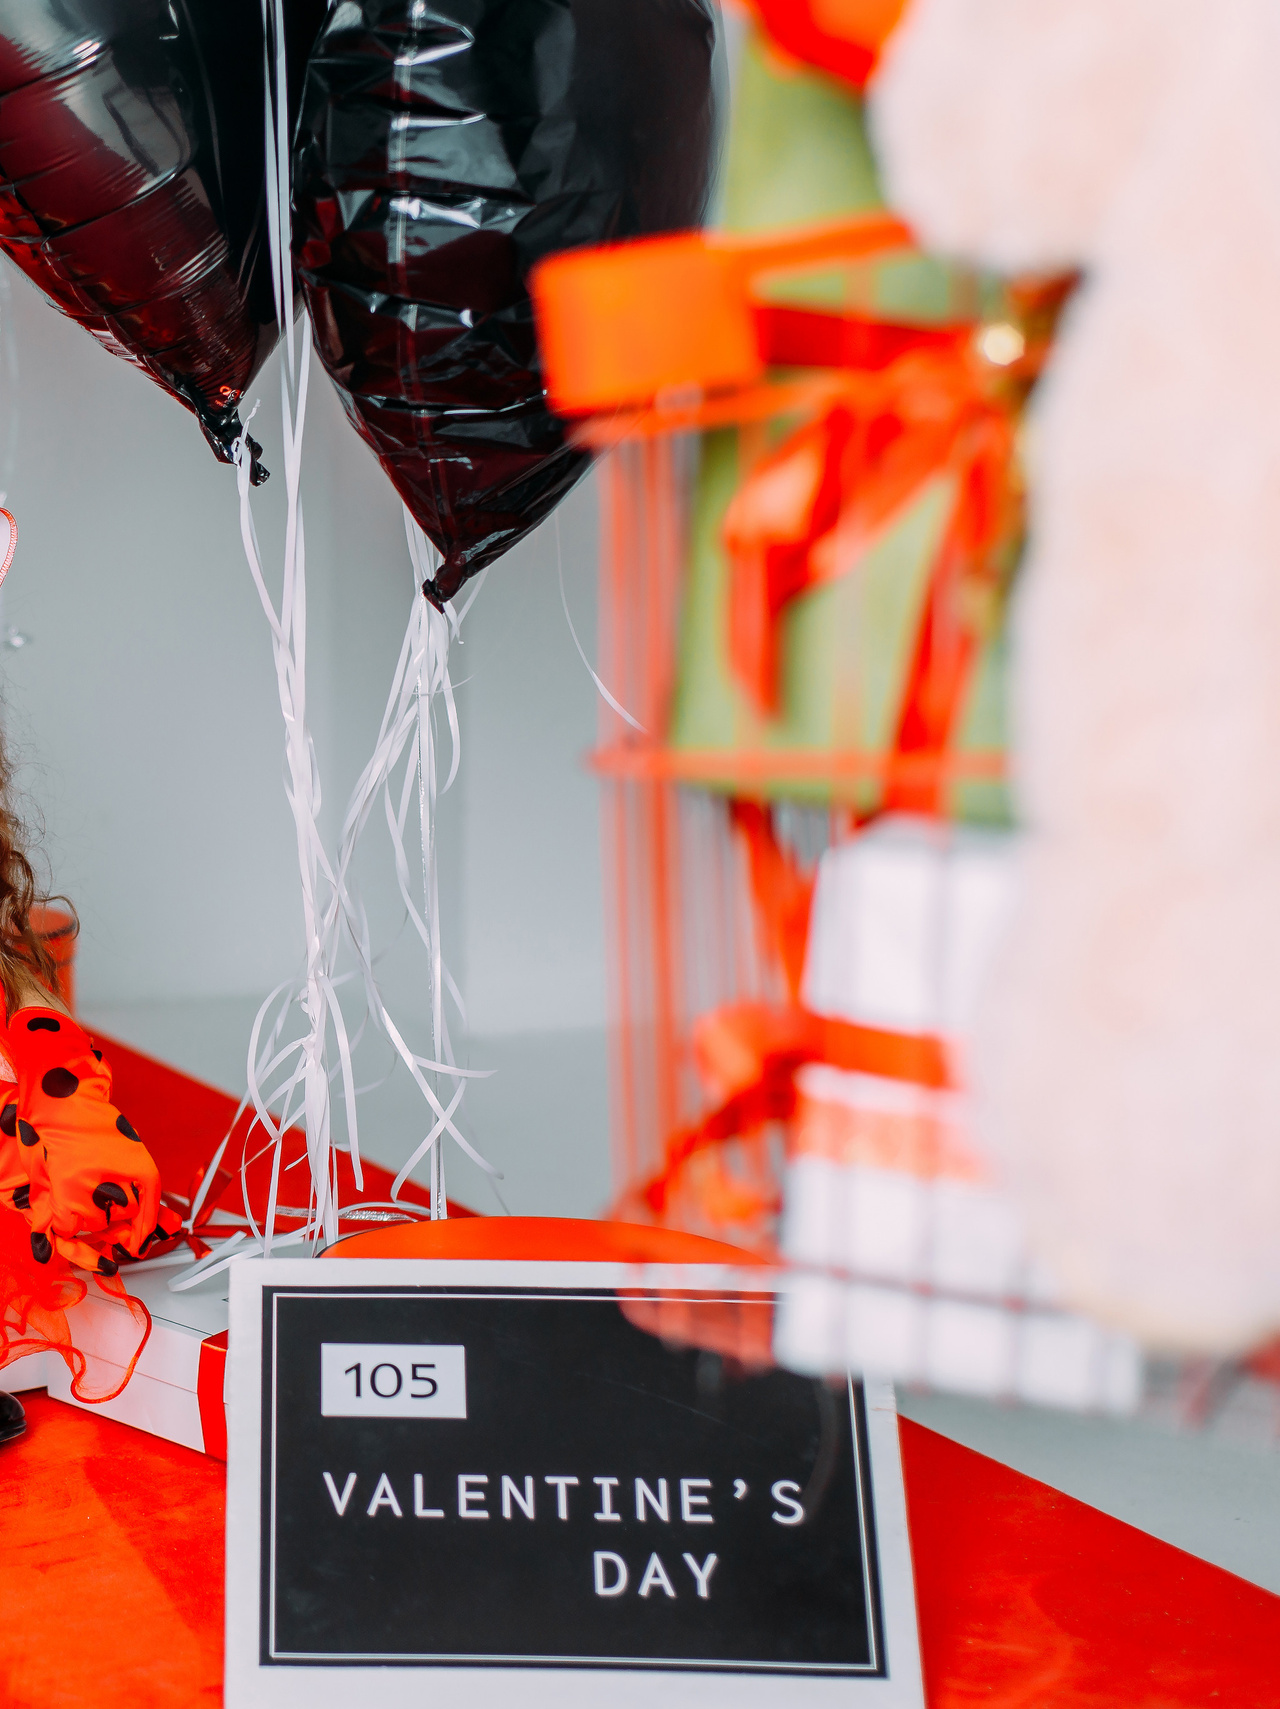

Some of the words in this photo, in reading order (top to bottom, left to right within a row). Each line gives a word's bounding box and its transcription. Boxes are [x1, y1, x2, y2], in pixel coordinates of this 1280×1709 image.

[343, 1361, 438, 1400] 105
[322, 1470, 805, 1526] VALENTINE’S
[592, 1550, 719, 1599] DAY
